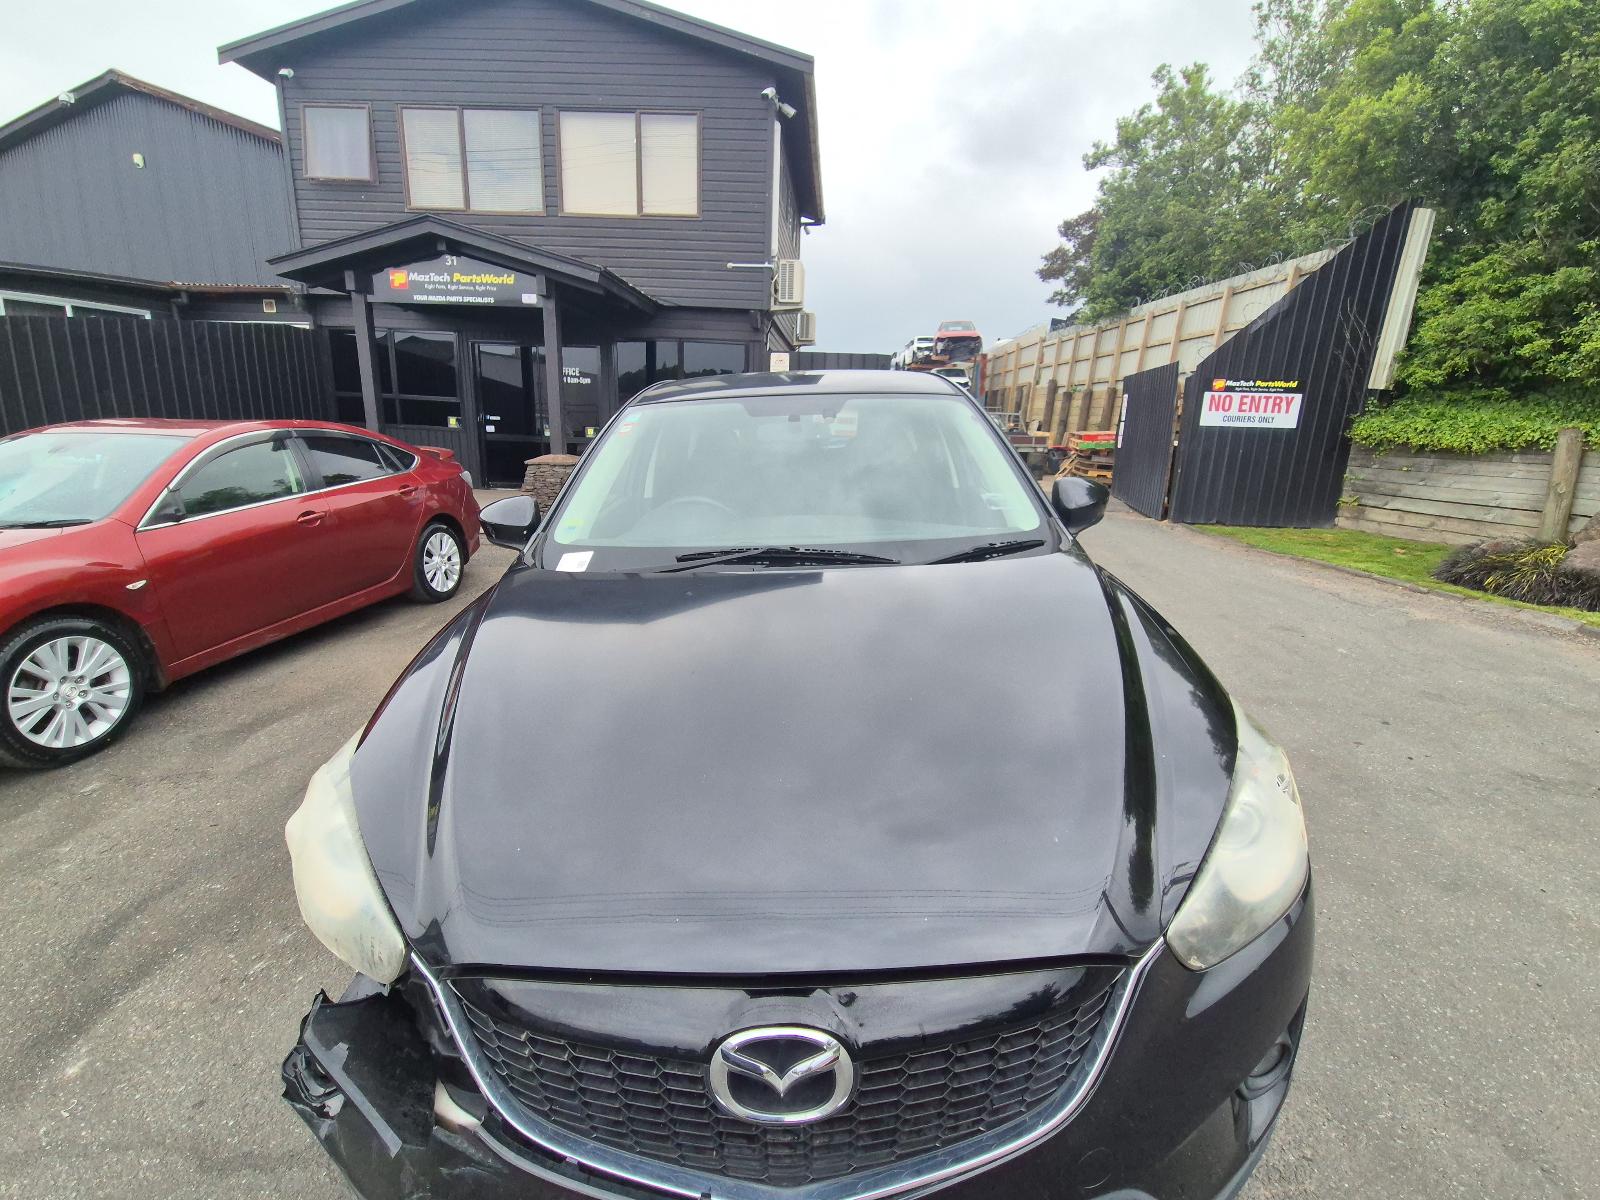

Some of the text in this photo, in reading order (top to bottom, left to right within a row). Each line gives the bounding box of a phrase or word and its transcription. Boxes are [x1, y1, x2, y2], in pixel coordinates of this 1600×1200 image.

[445, 255, 457, 266] 31
[408, 272, 451, 282] MazTech
[453, 272, 515, 285] PartsWorld
[446, 295, 462, 303] PARTS
[562, 367, 580, 376] FFICE
[1255, 380, 1298, 388] PartsWorld
[1208, 394, 1295, 414] NO ENTRY
[1222, 415, 1275, 424] COURIERS ONLY
